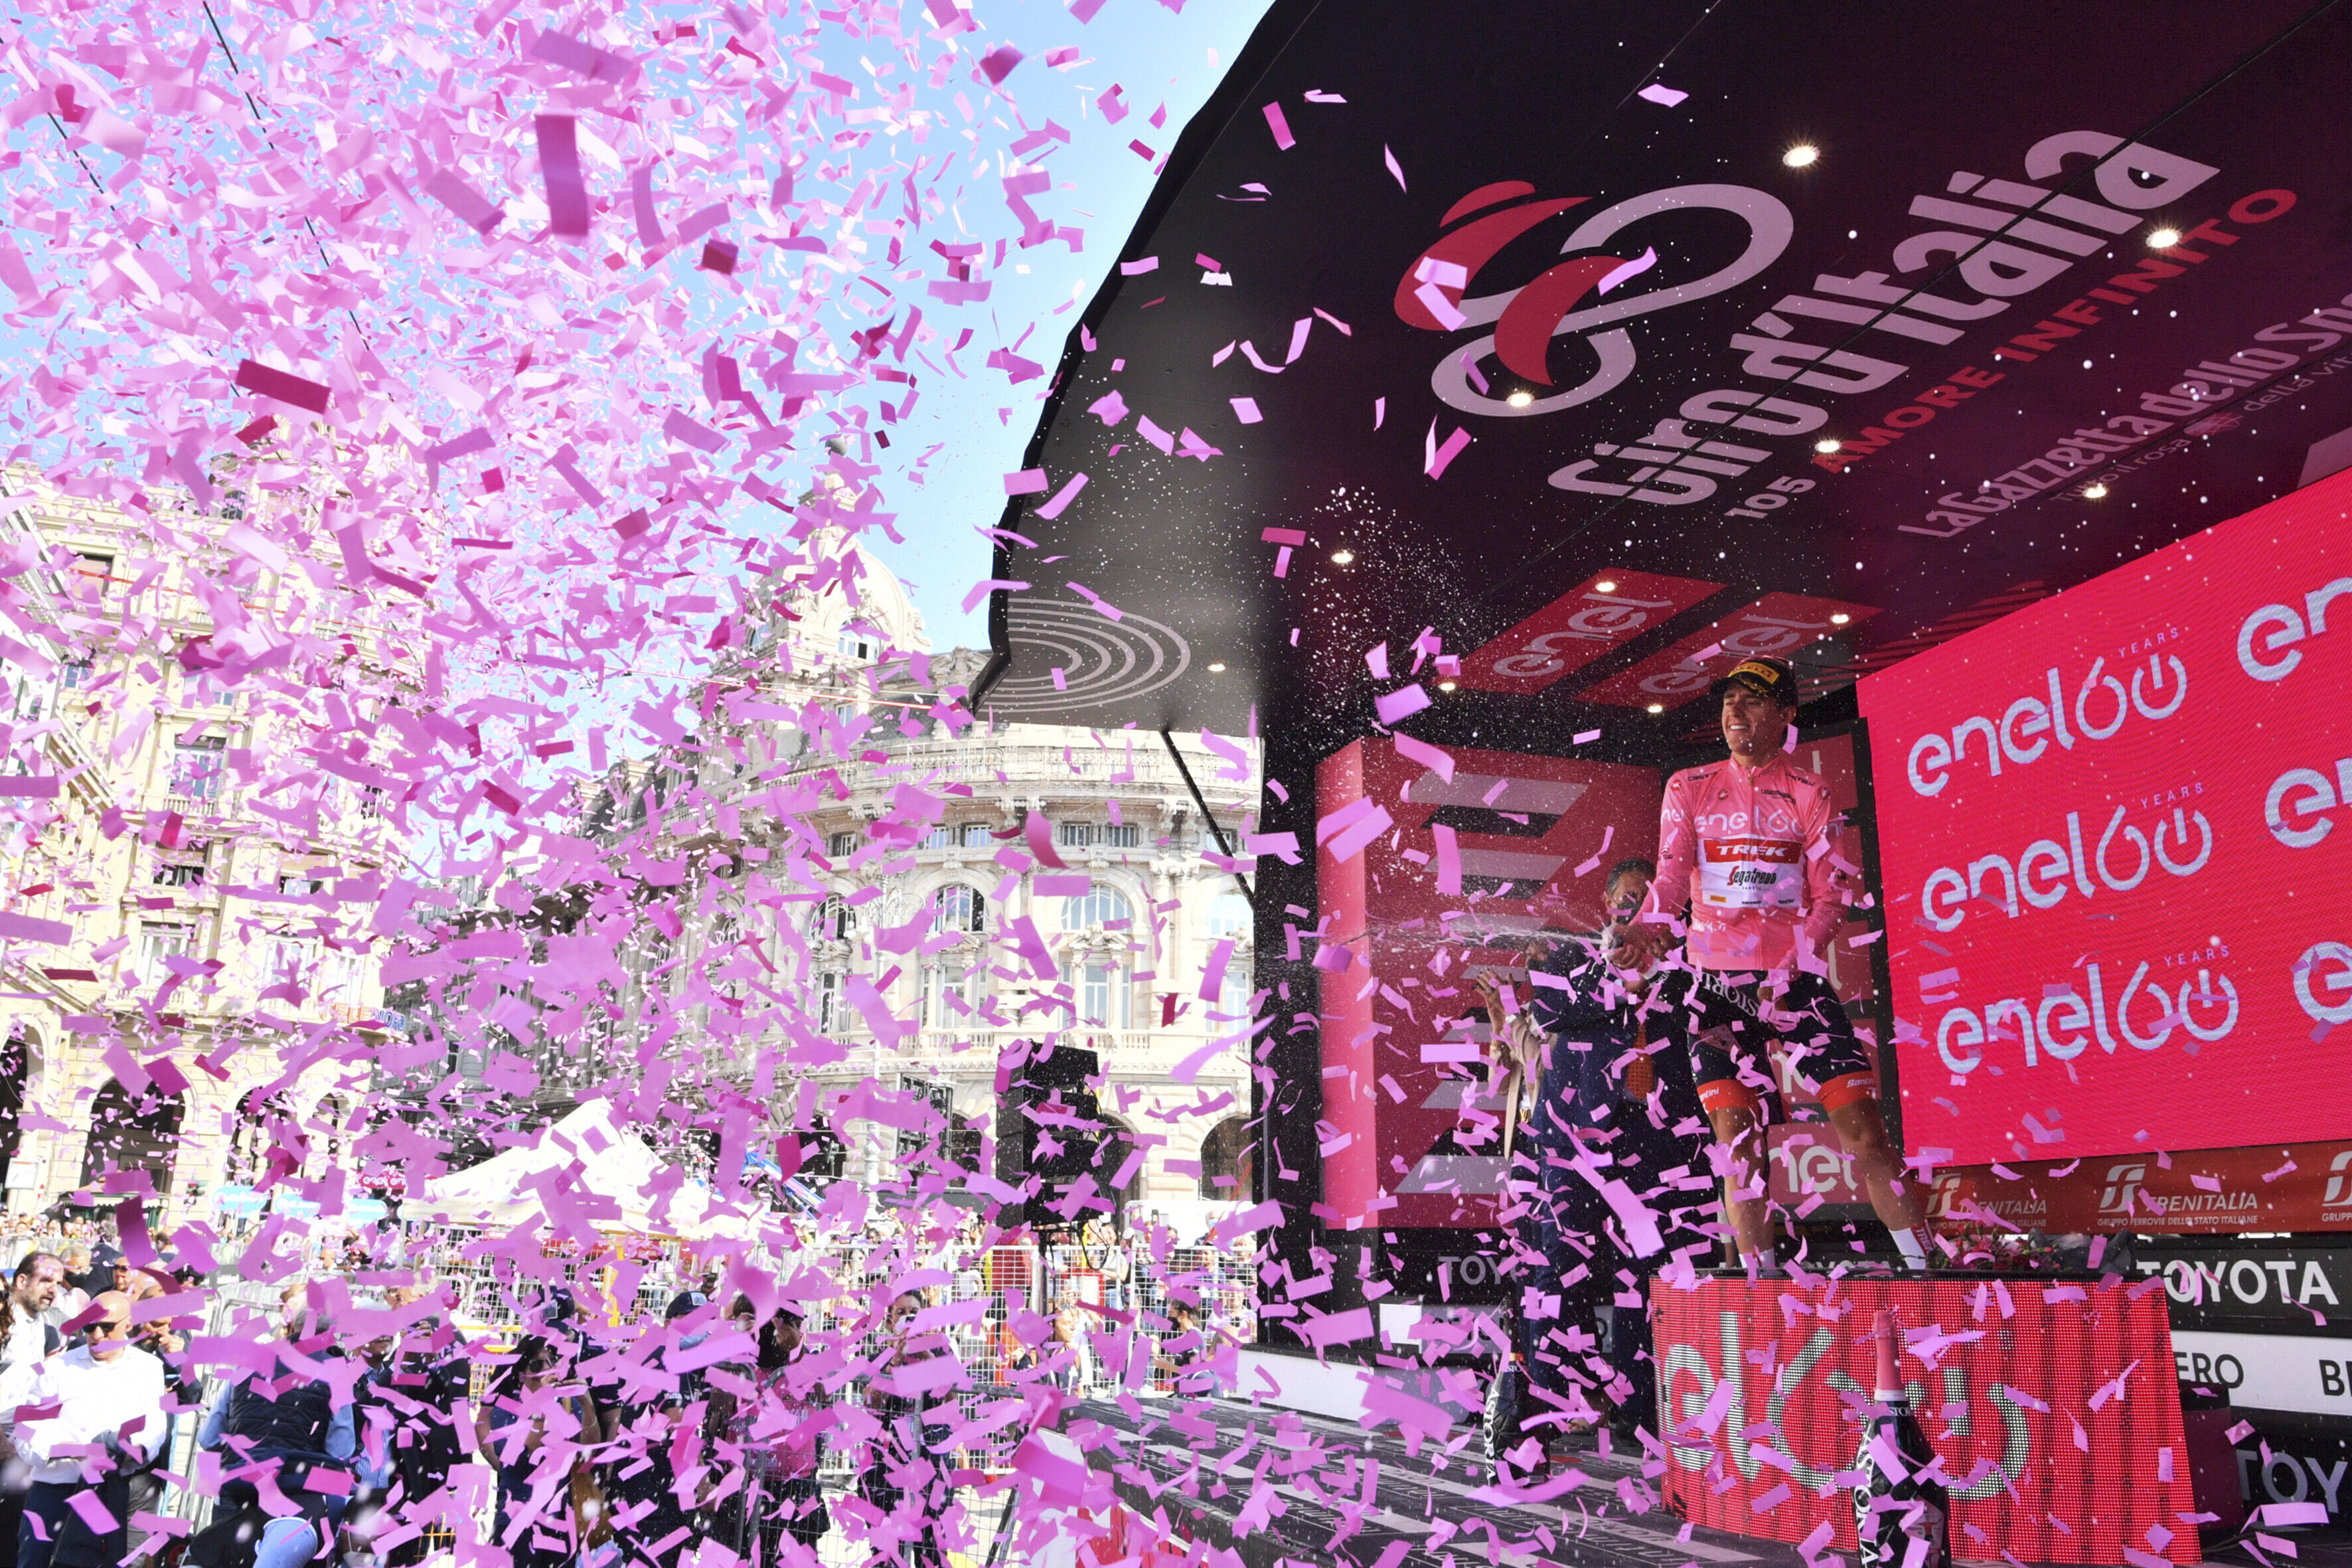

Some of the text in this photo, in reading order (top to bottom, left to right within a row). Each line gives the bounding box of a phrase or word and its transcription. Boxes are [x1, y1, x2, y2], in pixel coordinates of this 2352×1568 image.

[1724, 189, 2298, 518] 105 AMORE INFINITO
[2050, 473, 2119, 501] Tuo
[2134, 438, 2191, 465] rosa
[2243, 378, 2315, 412] della
[2311, 353, 2352, 376] vit
[1492, 593, 1674, 677] enel
[2118, 627, 2179, 658] YEARS
[2141, 782, 2204, 809] YEARS
[1716, 845, 1789, 857] TREK
[2164, 945, 2230, 967] YEARS
[2098, 1214, 2258, 1226] GRUPPO FERROVIE DELLO STATO ITALIANE
[2321, 1212, 2352, 1222] GRUPP
[2173, 1352, 2244, 1389] ERO
[1483, 1387, 1500, 1480] ASTORIA
